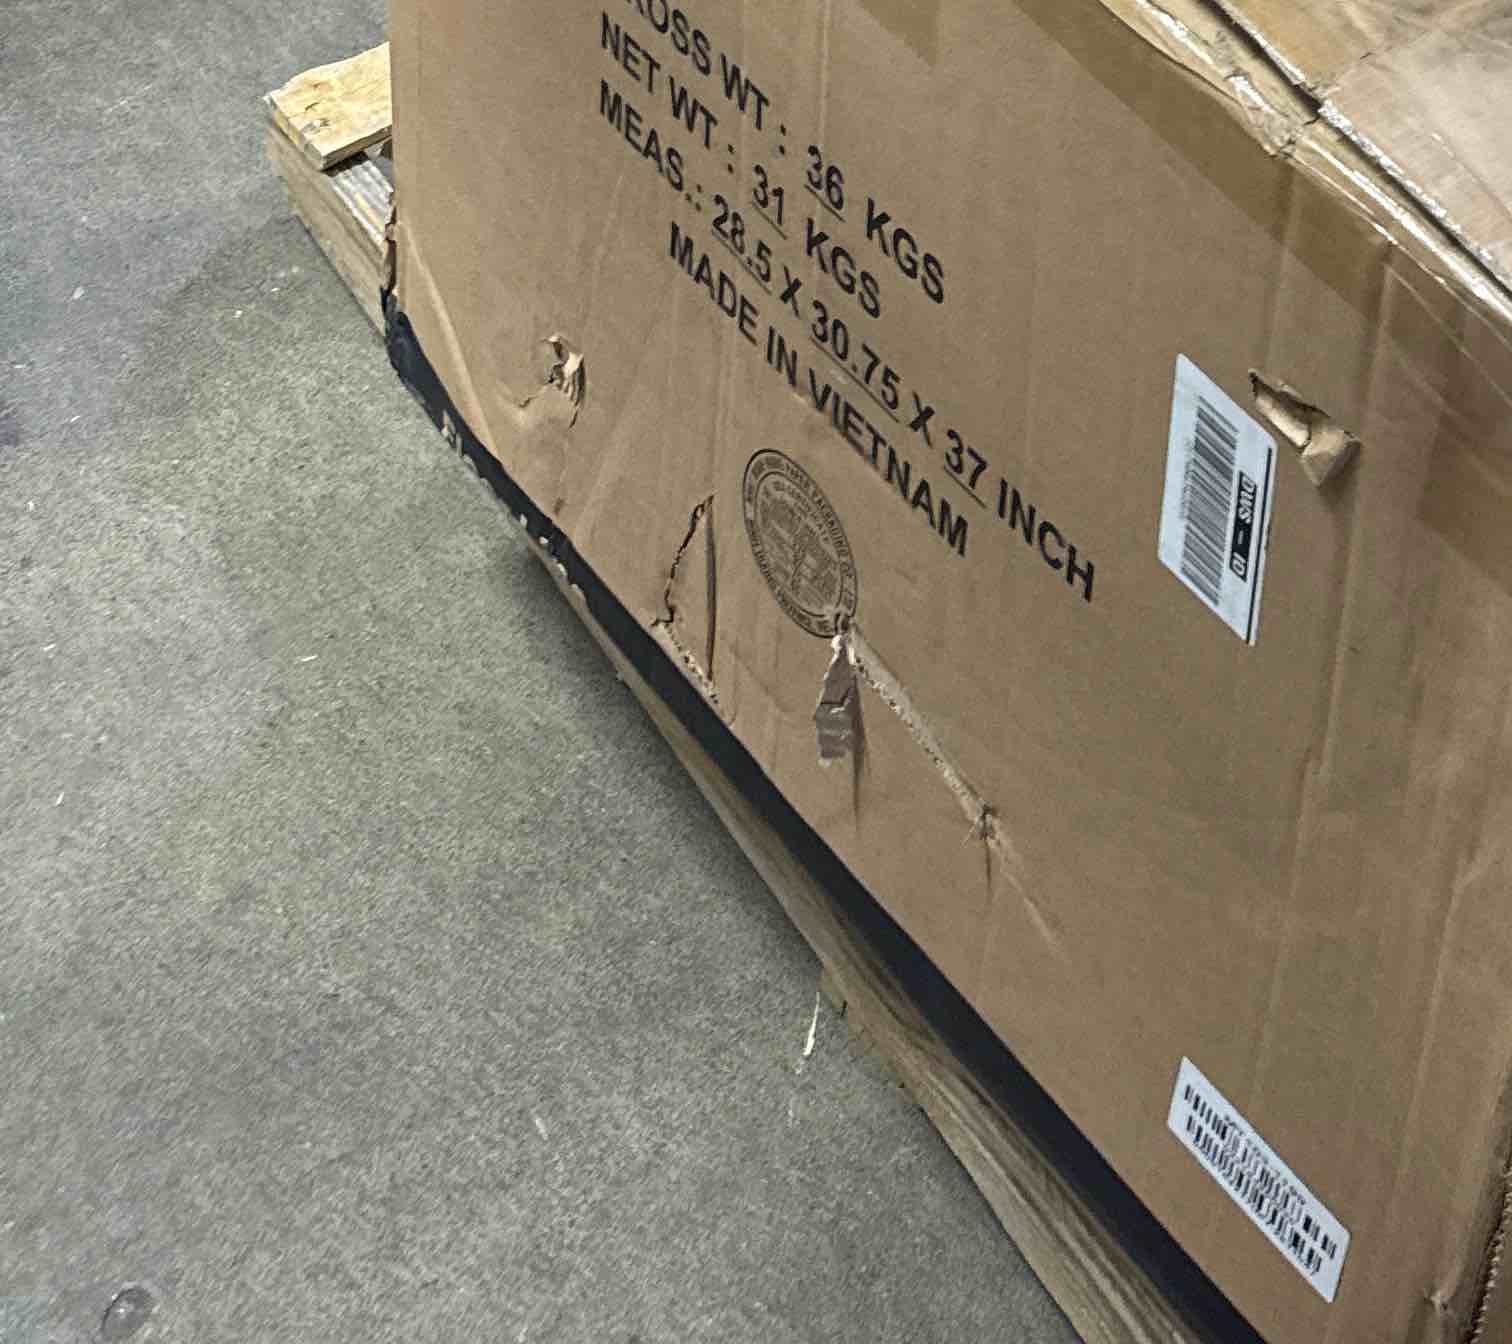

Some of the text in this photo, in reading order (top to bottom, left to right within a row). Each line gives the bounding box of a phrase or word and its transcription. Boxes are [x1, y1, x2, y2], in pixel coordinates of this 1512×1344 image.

[601, 11, 661, 94] NET
[753, 164, 785, 226] 31
[806, 217, 881, 319] KGS
[807, 145, 846, 211] 36
[865, 198, 945, 305] KGS
[669, 220, 970, 558] MADE IN VIETNAM
[712, 193, 773, 283] 28.5
[779, 264, 804, 319] X
[811, 299, 901, 411] 30.75
[909, 390, 937, 450] X
[944, 429, 988, 491] 37
[998, 479, 1096, 603] INCH
